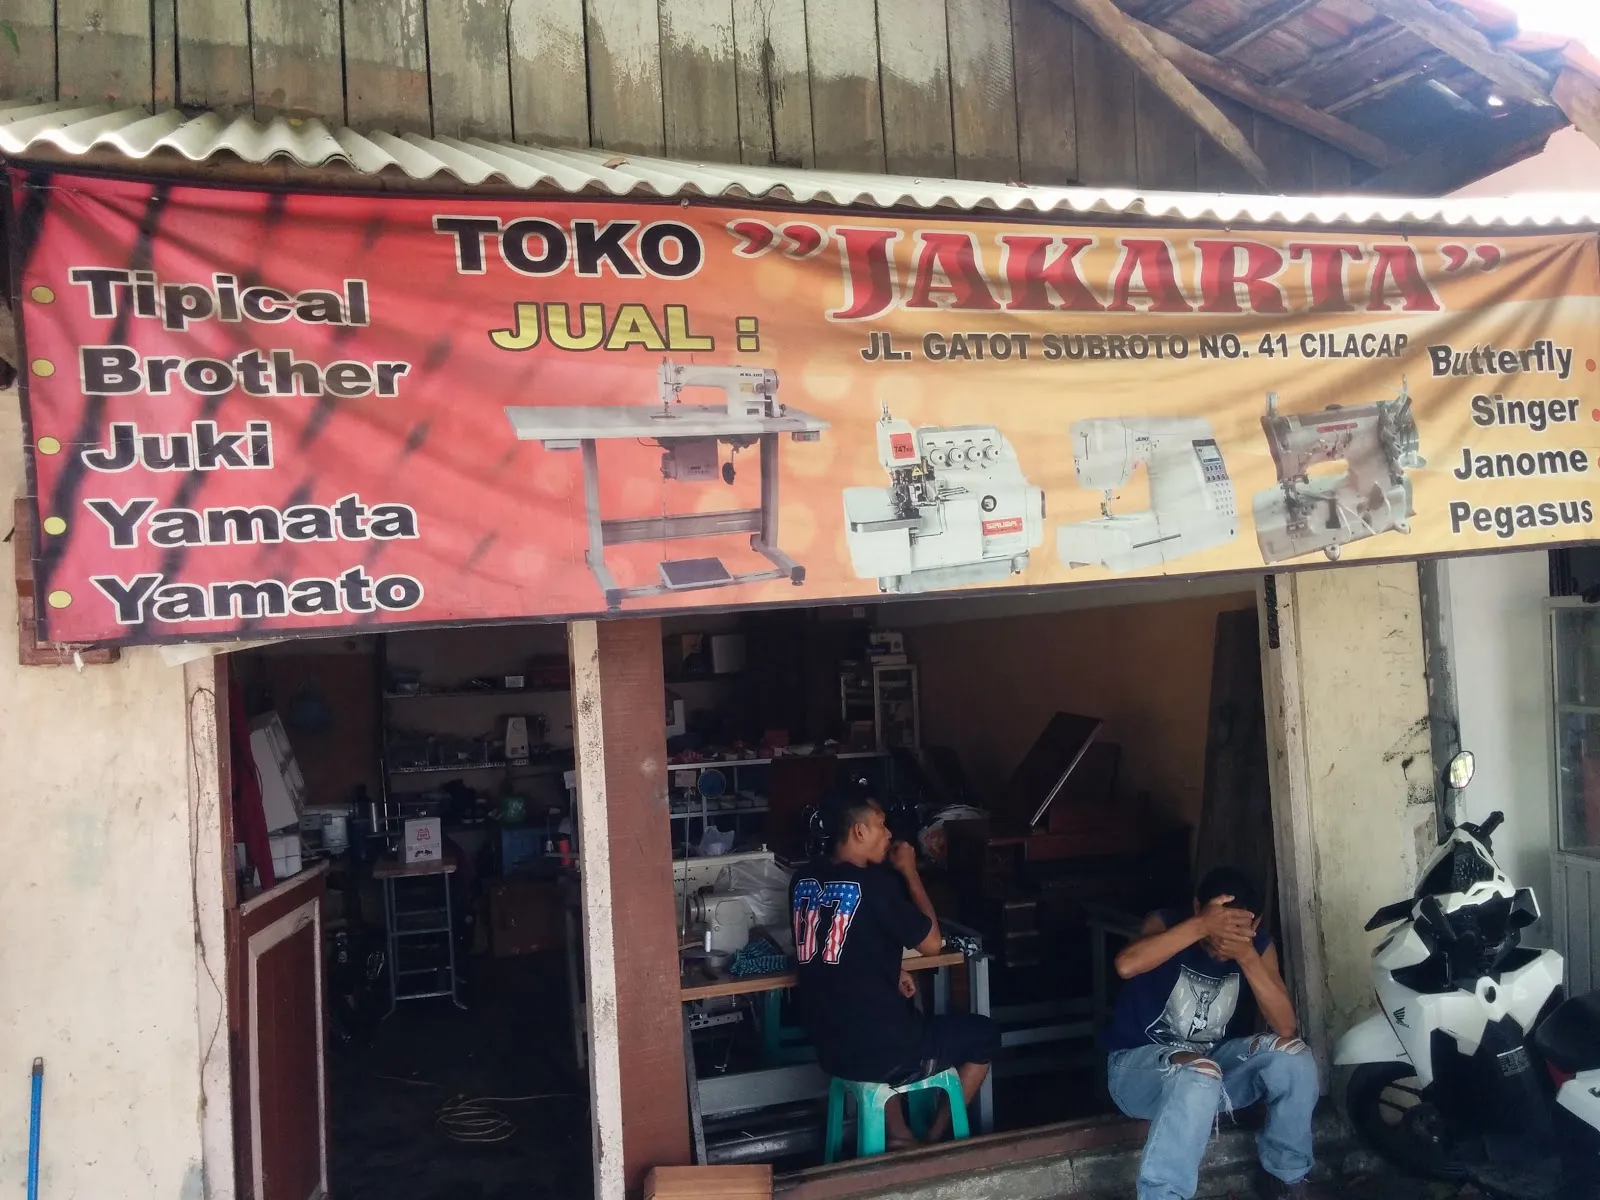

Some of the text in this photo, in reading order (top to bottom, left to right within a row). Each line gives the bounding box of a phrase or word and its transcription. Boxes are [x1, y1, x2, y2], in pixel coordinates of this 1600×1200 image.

[433, 215, 705, 280] TOKO
[69, 266, 370, 332] Tipical
[488, 301, 715, 352] JUAL
[860, 331, 1409, 362] JL. GATOT SUBROTO NO. 41 CILACAP
[79, 345, 411, 398] Brother
[1427, 339, 1573, 380] Butterfly
[1470, 393, 1580, 432] Singer
[81, 420, 274, 473] Juki
[1453, 446, 1589, 482] Janome
[84, 493, 420, 549] Yamata
[1448, 497, 1593, 538] Pegasus
[90, 565, 424, 625] Yamato
[793, 877, 862, 965] 07
